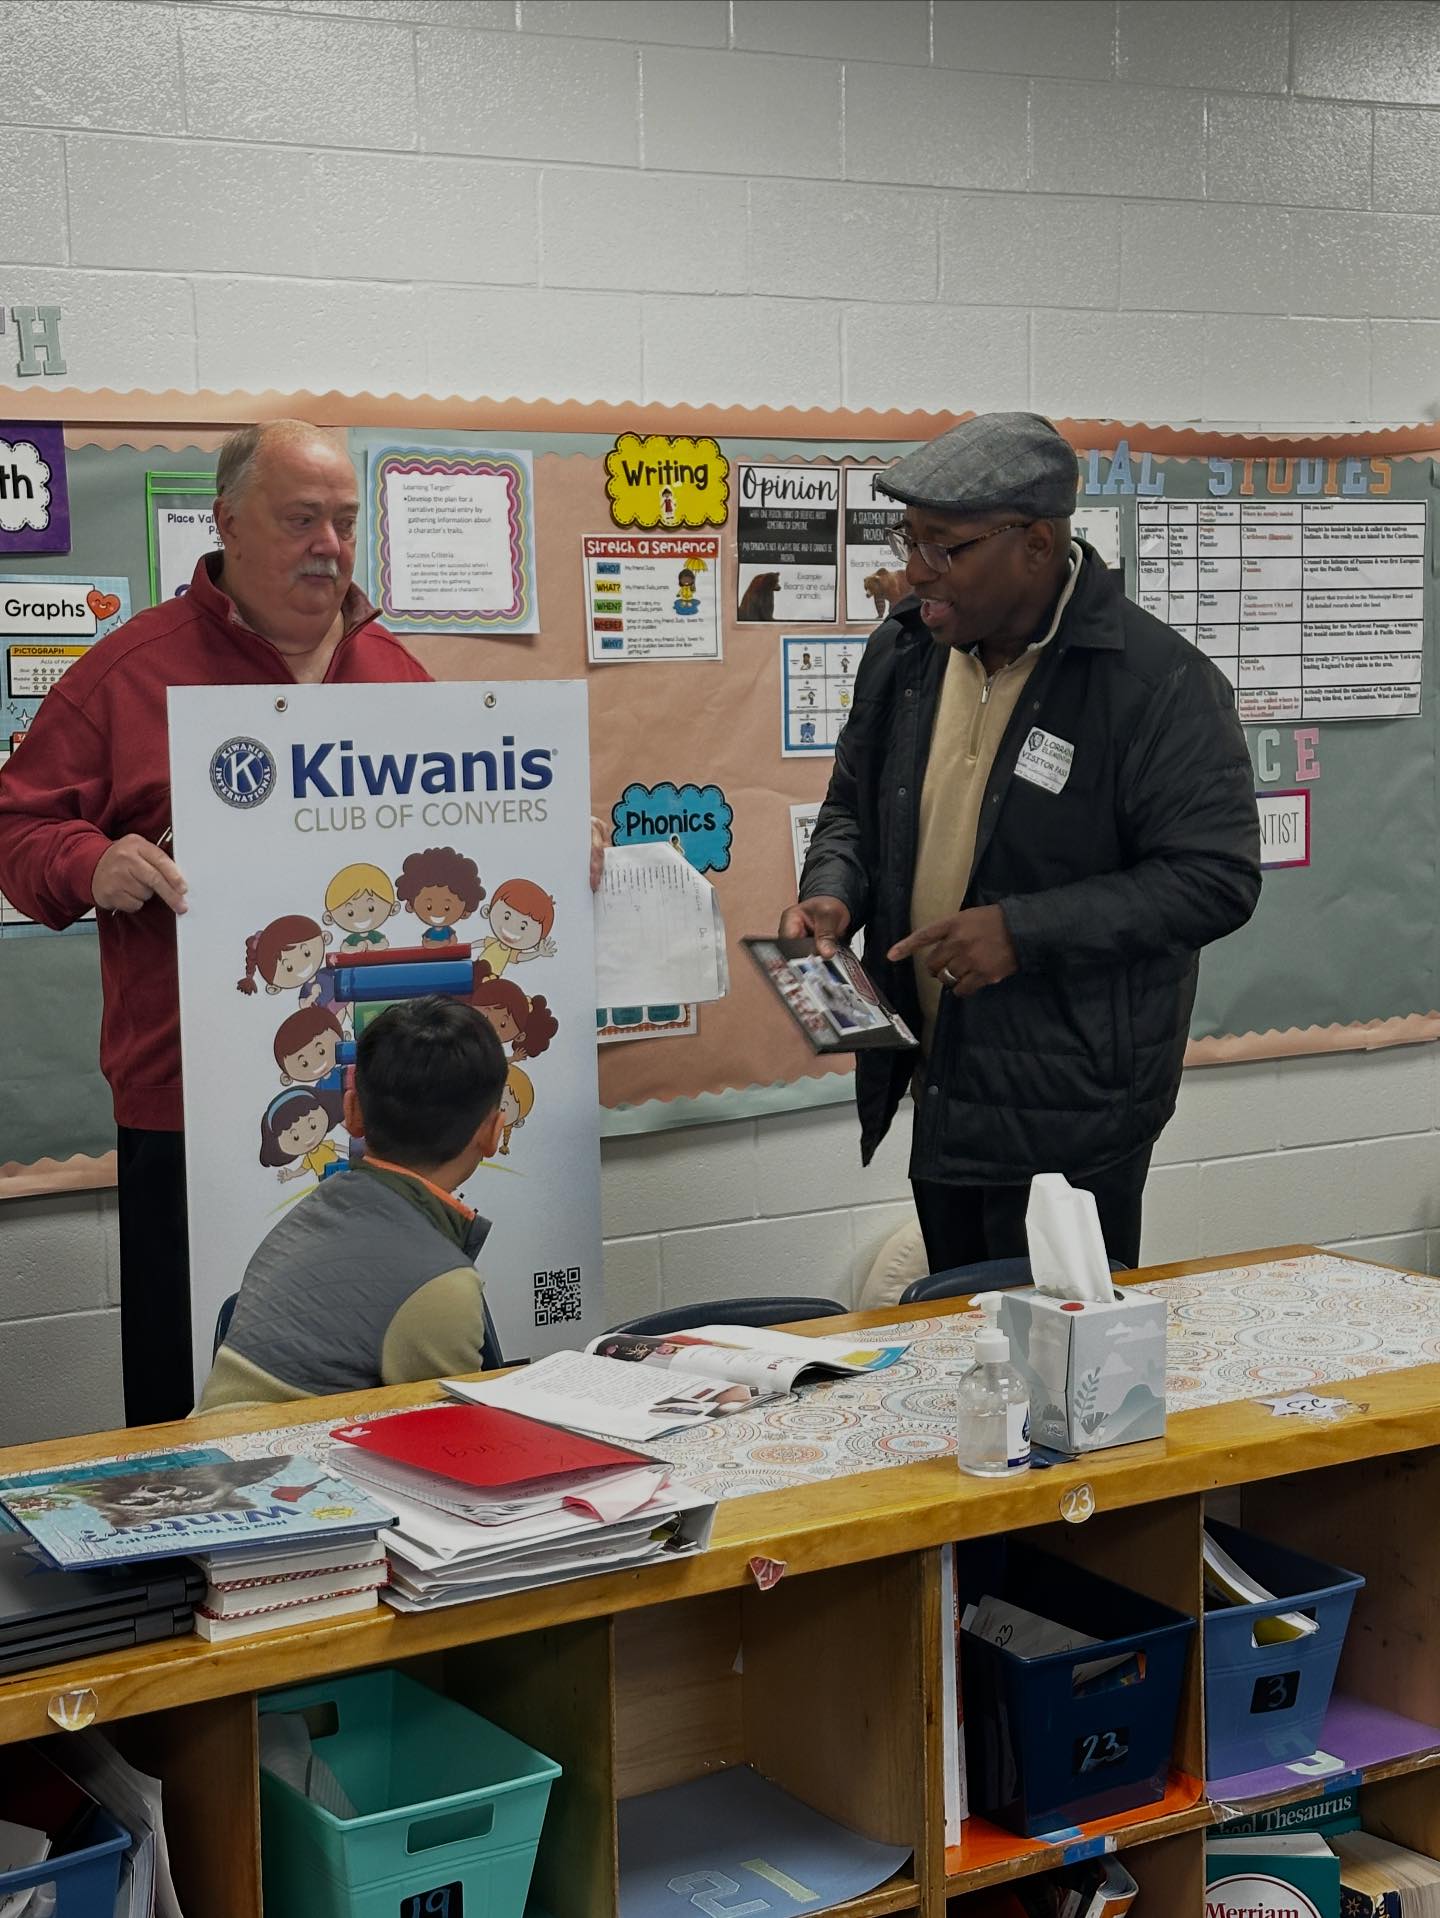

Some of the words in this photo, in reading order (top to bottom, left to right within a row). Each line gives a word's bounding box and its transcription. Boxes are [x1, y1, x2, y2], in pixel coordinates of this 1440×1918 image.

[622, 459, 708, 490] Writing
[1077, 441, 1165, 495] IAL
[1208, 455, 1392, 495] STUDIES
[742, 467, 838, 507] Opinion
[167, 513, 195, 523] Place
[198, 514, 215, 523] Val
[588, 540, 635, 554] Stretch
[639, 541, 650, 554] a
[652, 541, 716, 554] Sentence
[596, 583, 621, 592] WHAT?
[5, 600, 85, 620] Graphs
[596, 601, 622, 610] WHEN?
[222, 743, 264, 759] KIWANIS
[1022, 751, 1054, 771] VISITOR
[230, 752, 259, 795] K
[291, 735, 554, 798] Kiwanis
[216, 766, 272, 803] INTERNATIONAL
[294, 806, 367, 832] CLUB
[375, 804, 414, 829] OF
[422, 799, 548, 827] CONYERS
[626, 808, 716, 836] Phonics
[1064, 1488, 1094, 1517] 23
[80, 1505, 302, 1542] Winter?
[194, 1527, 224, 1537] You
[230, 1523, 252, 1532] Do
[260, 1520, 287, 1530] How
[115, 1536, 140, 1545] It's
[147, 1530, 189, 1541] Know
[995, 1624, 1013, 1647] 23
[1268, 1675, 1288, 1708] 3
[1081, 1732, 1129, 1772] 23
[1261, 1794, 1352, 1832] Thesaurus
[1204, 1902, 1299, 1918] Merriam
